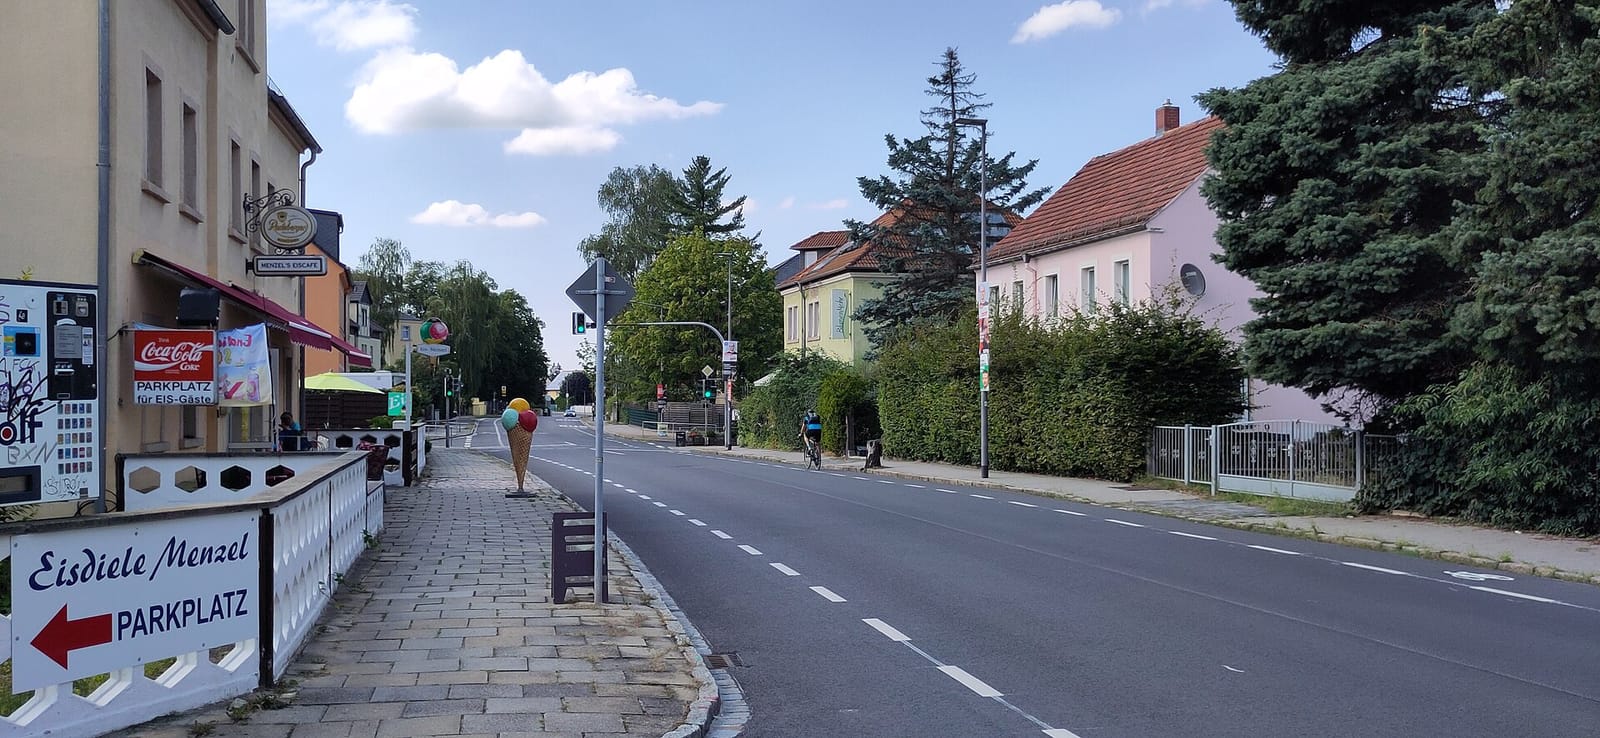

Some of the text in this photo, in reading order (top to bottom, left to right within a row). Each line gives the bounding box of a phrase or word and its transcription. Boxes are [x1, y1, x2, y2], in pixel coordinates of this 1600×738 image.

[141, 341, 205, 362] Coca-Cola
[137, 381, 212, 392] PARKPLATZ
[137, 394, 212, 404] für EIS-Gäste
[29, 532, 249, 591] Eisdiele Menzel
[118, 588, 248, 641] PARKPLATZ
